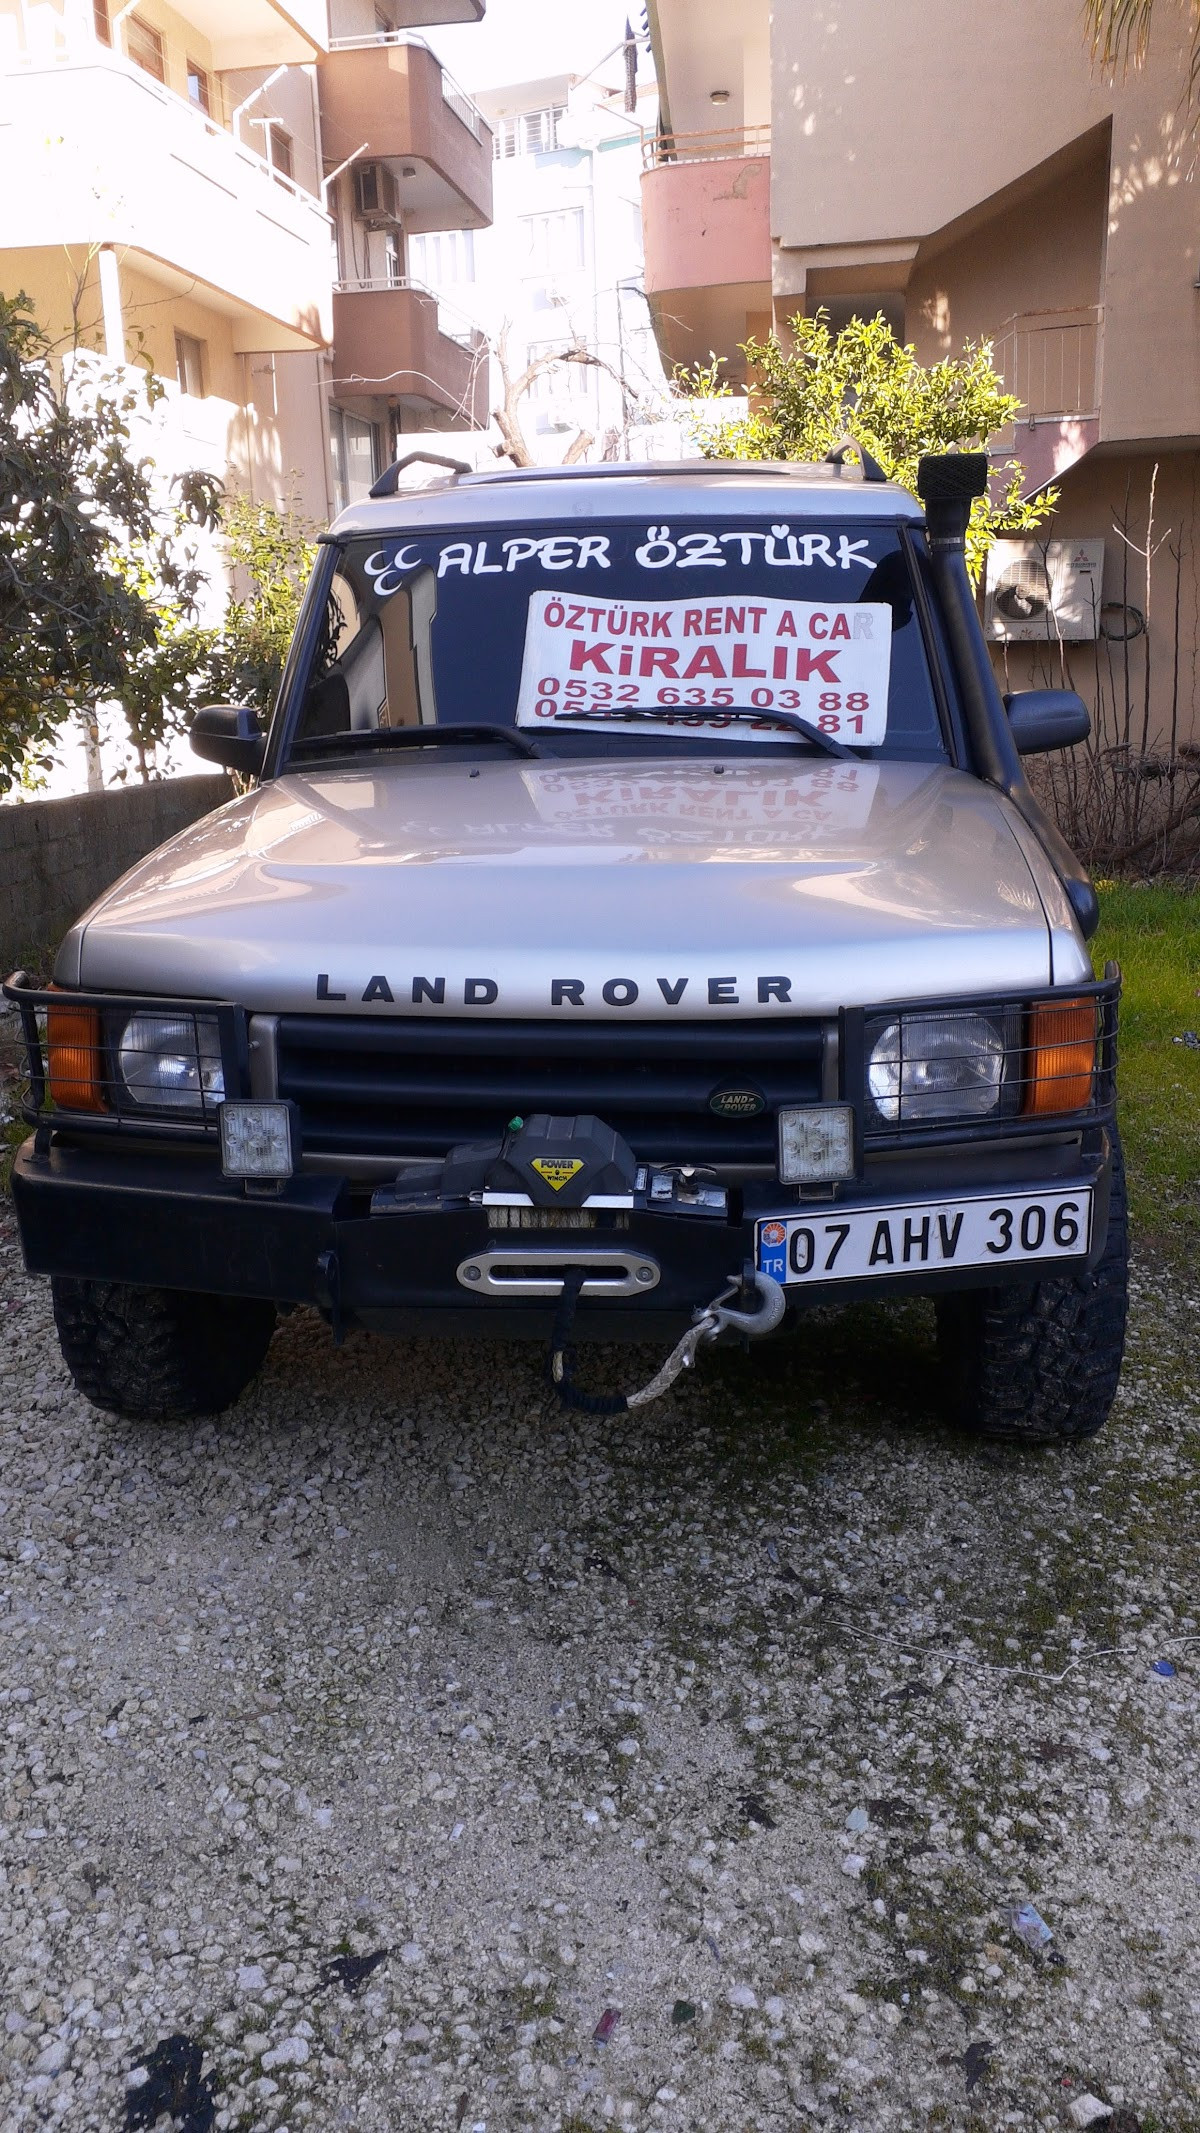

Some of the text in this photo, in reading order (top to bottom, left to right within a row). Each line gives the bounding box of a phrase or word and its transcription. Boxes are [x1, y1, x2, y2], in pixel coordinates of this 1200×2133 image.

[437, 524, 877, 579] ALPER ÖZTÜRK
[544, 597, 673, 638] ÖZTÜRK
[683, 607, 767, 637] RENT
[776, 610, 798, 637] A
[537, 677, 870, 712] 0532 635 03 88
[817, 714, 864, 734] 81
[316, 974, 792, 1006] LAND ROVER
[720, 1095, 748, 1104] LAND
[541, 1160, 574, 1169] POWER
[789, 1202, 1079, 1274] 07 AHV 306
[763, 1259, 784, 1273] TR
